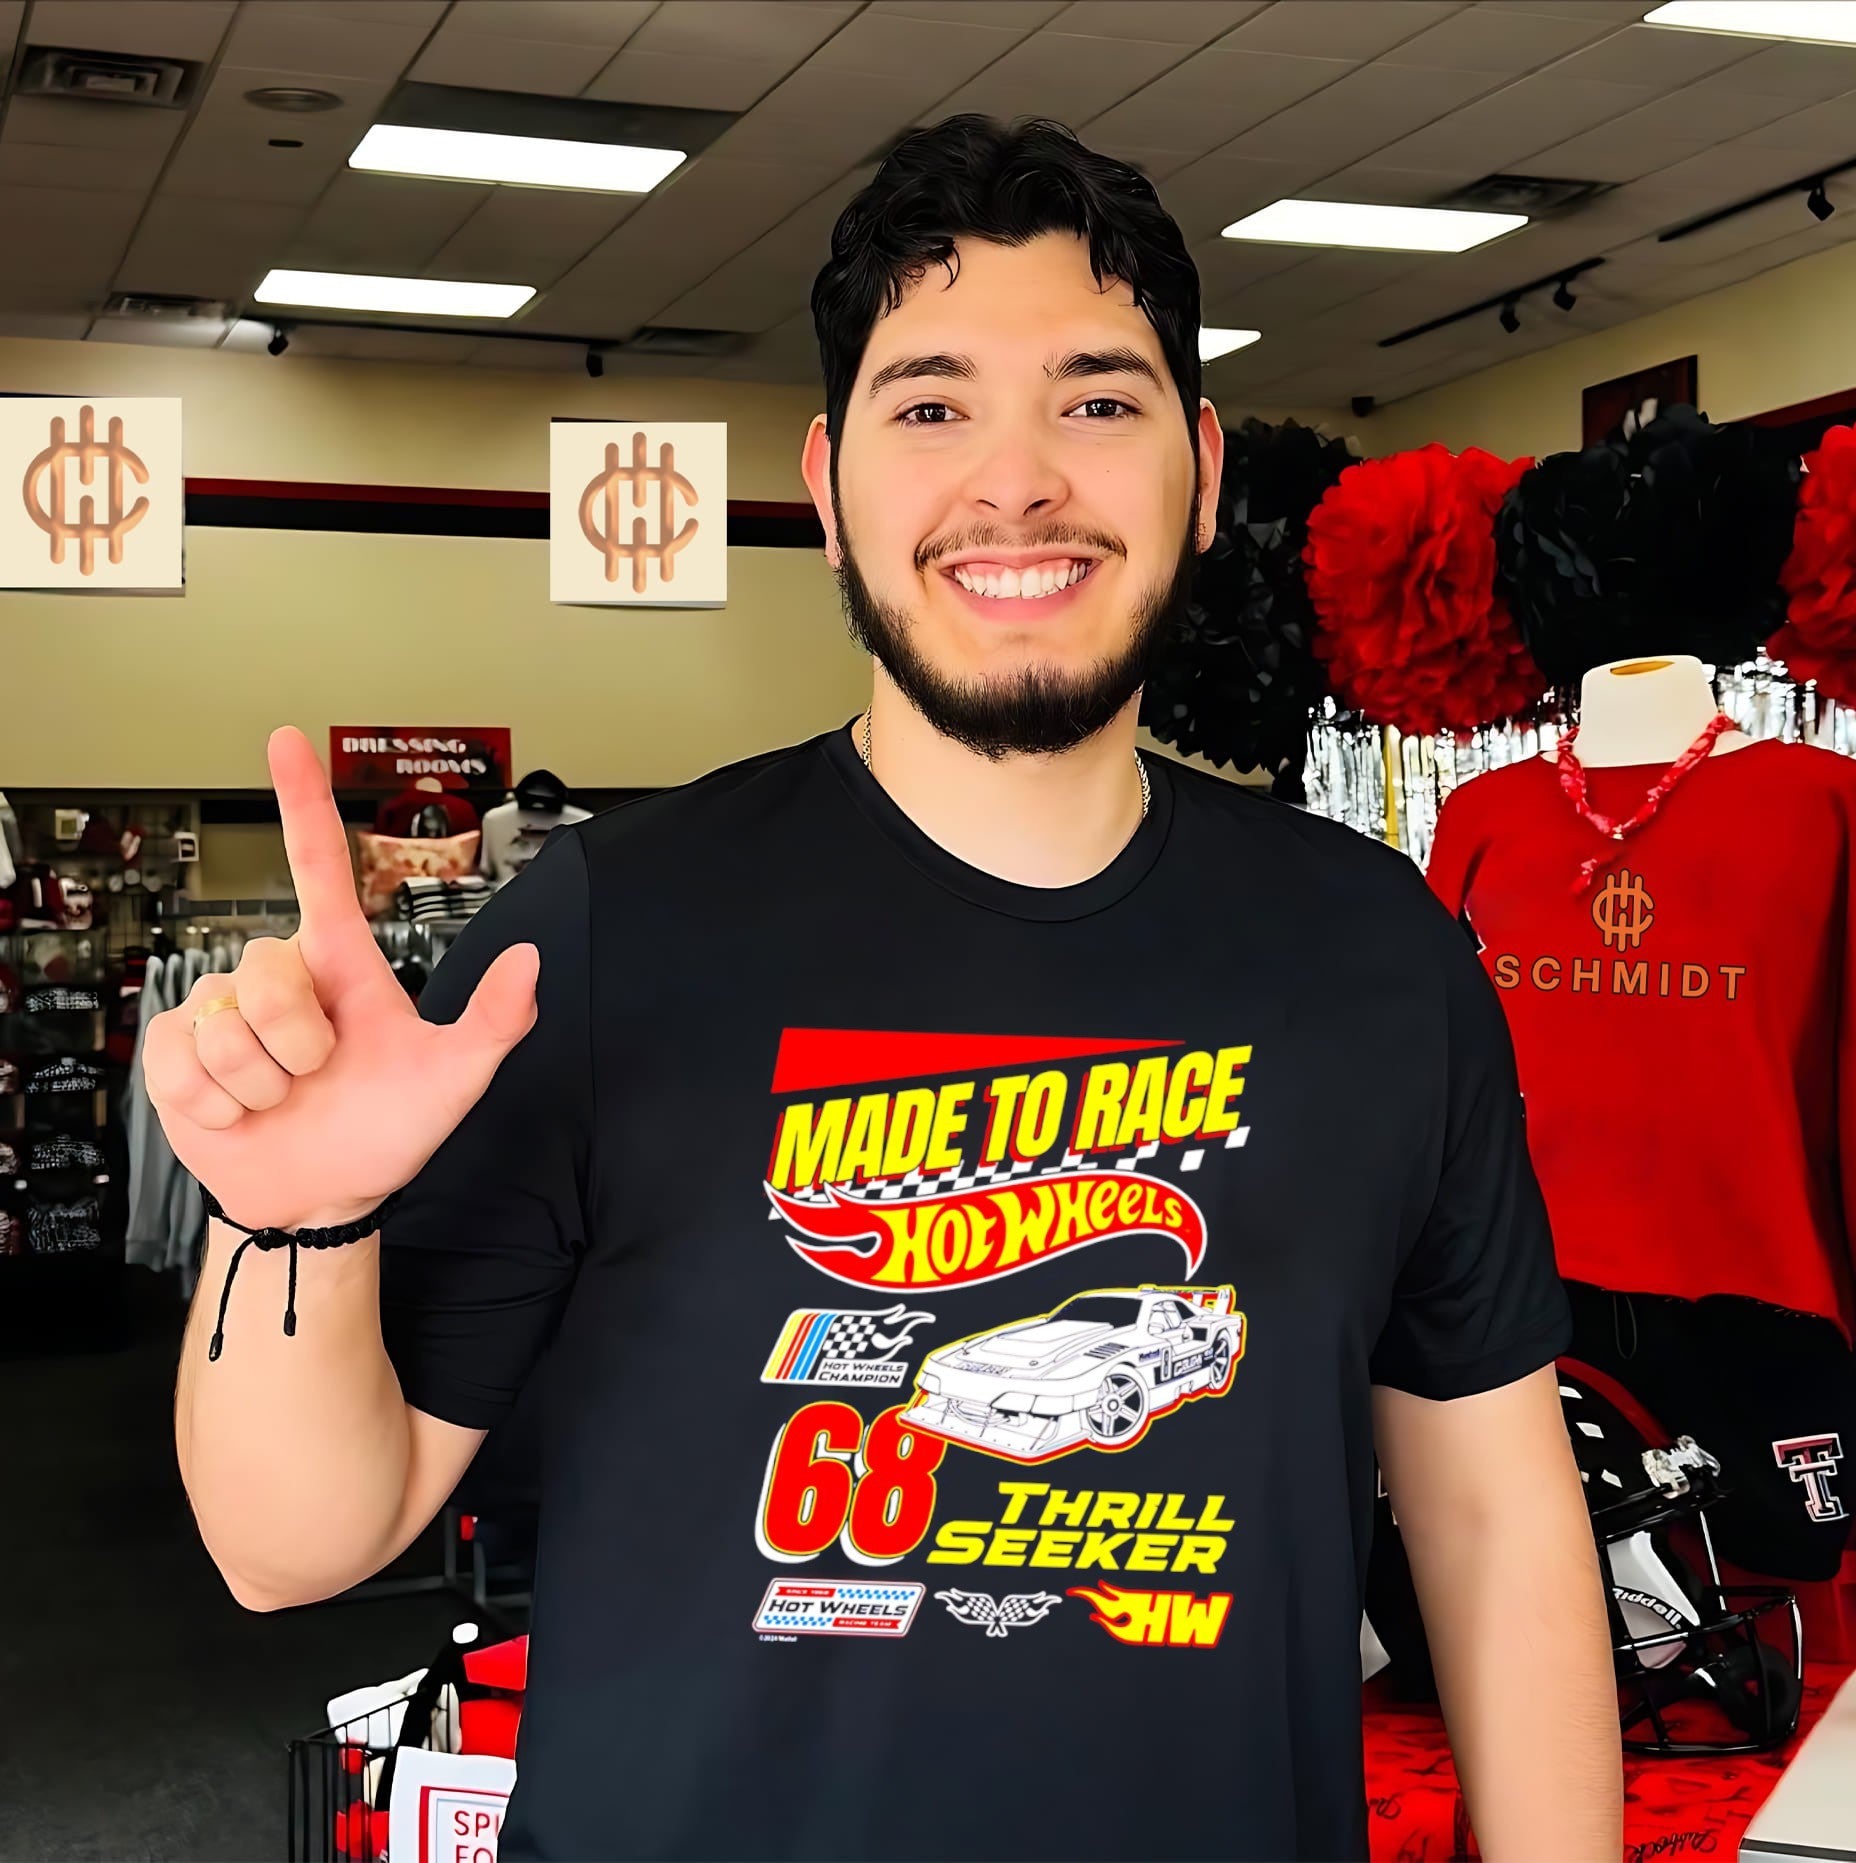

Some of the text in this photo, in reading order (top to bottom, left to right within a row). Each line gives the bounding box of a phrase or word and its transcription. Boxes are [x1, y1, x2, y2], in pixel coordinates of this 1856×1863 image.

[1493, 954, 1747, 1000] SCHMIDT
[768, 1045, 1253, 1192] MADE TO RACE
[818, 1371, 900, 1383] CHAMPION
[822, 1362, 904, 1372] HOT WHEELS
[755, 1401, 947, 1566] 68
[997, 1481, 1236, 1533] THRILL
[926, 1521, 1227, 1574] SEEKER
[768, 1599, 909, 1616] HOT WHEELS
[1120, 1590, 1234, 1648] HW
